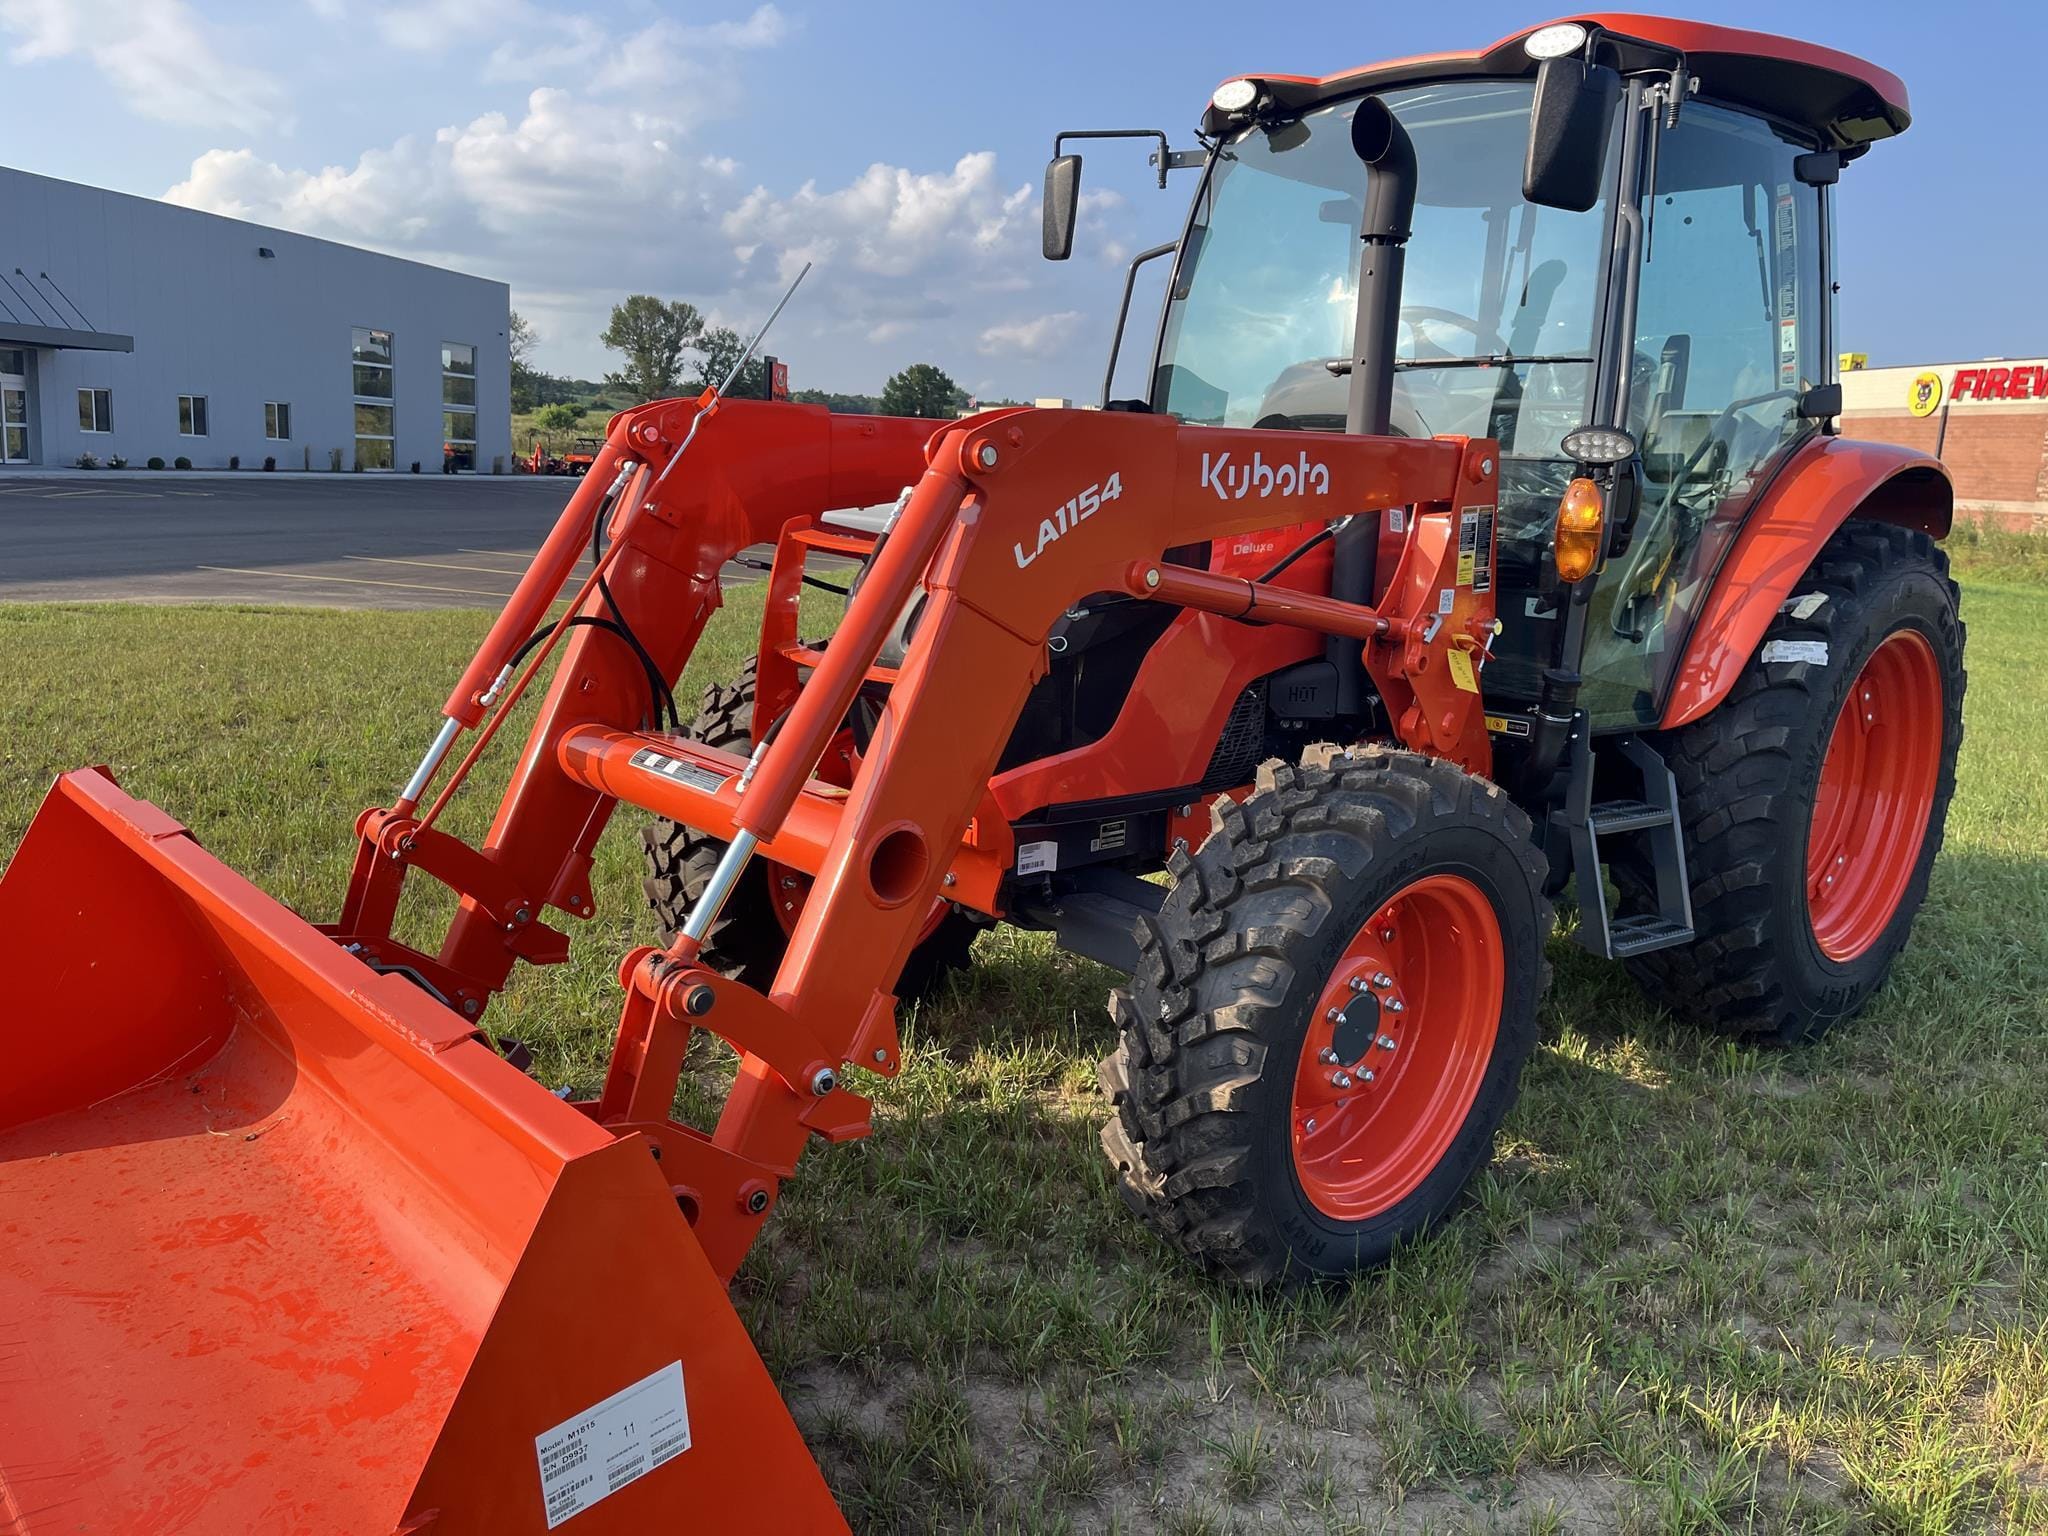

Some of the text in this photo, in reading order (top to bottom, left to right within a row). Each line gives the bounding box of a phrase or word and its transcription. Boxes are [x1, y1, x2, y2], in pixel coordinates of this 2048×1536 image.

[1200, 450, 1330, 500] Kubota
[1013, 471, 1124, 570] LA1154
[1232, 541, 1275, 556] Deluxe
[1288, 686, 1318, 702] HOT
[540, 1420, 596, 1455] Model M1815
[543, 1463, 557, 1474] S/N
[562, 1444, 588, 1464] D9937
